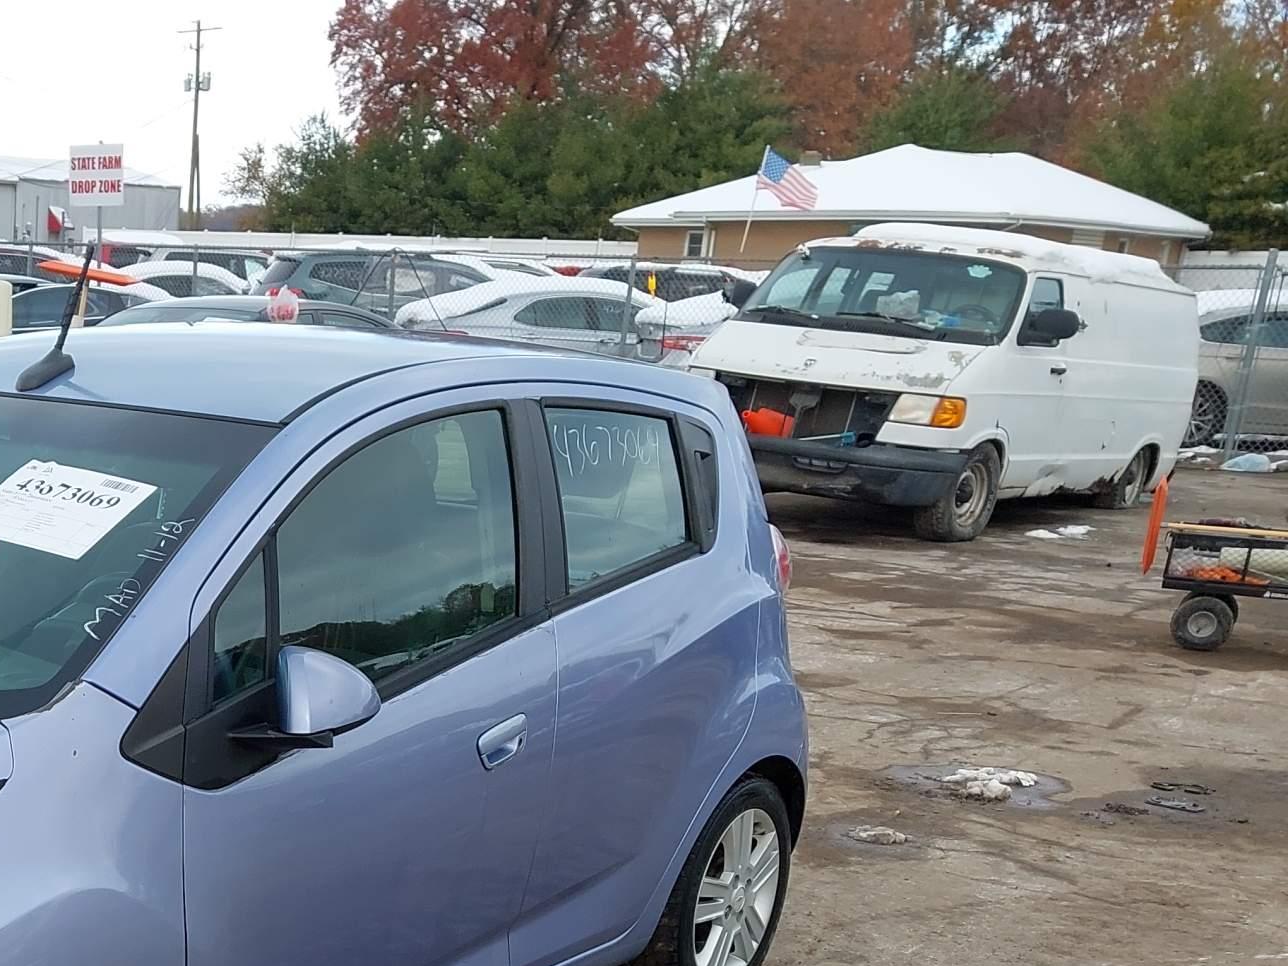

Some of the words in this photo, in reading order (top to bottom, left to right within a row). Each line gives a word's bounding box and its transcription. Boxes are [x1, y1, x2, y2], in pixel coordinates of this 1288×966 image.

[71, 157, 96, 170] STATE
[98, 155, 122, 169] FARM
[72, 180, 96, 193] DROP
[99, 180, 121, 193] ZONE
[83, 578, 141, 641] MAD
